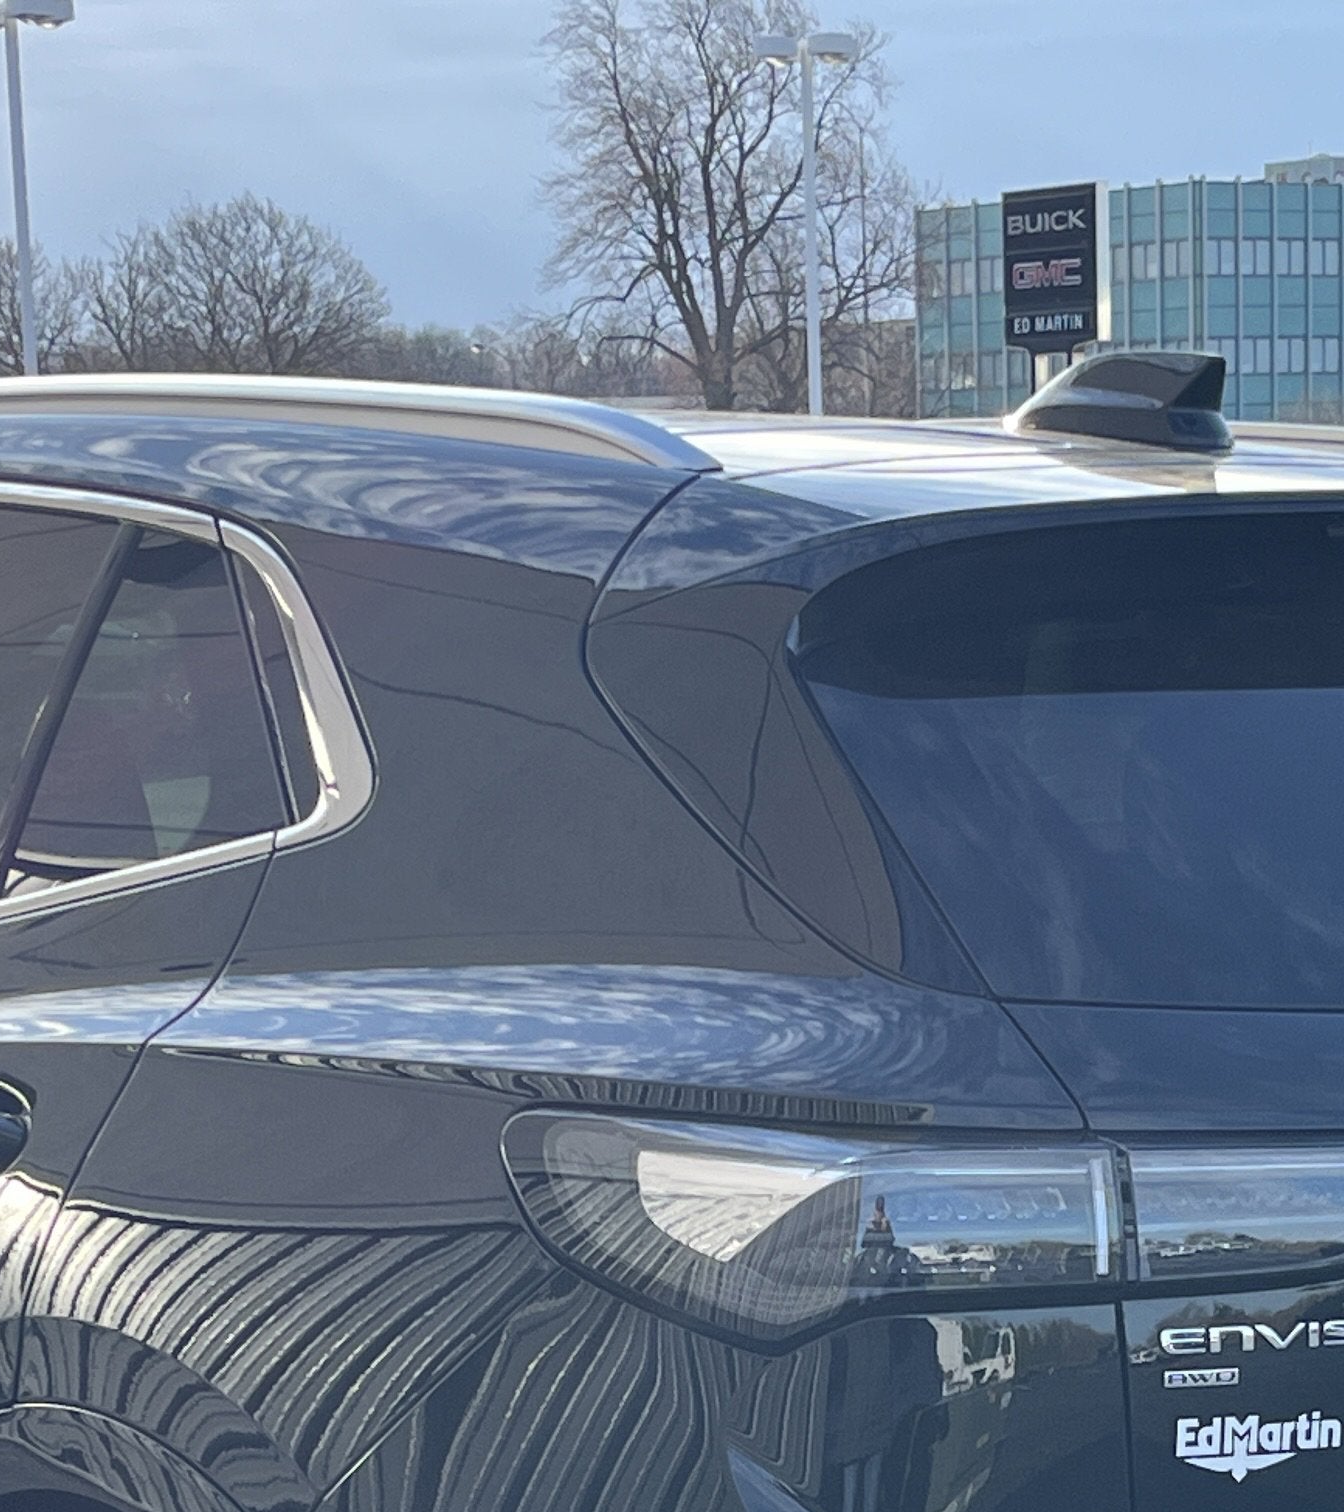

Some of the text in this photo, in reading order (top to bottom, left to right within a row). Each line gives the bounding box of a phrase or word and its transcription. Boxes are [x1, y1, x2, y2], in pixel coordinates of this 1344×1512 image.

[1007, 209, 1087, 236] BUICK
[1012, 257, 1082, 289] GMC
[1014, 313, 1084, 334] ED MARTIN
[1165, 1370, 1238, 1387] AWD
[1175, 1410, 1342, 1460] EdMartin
